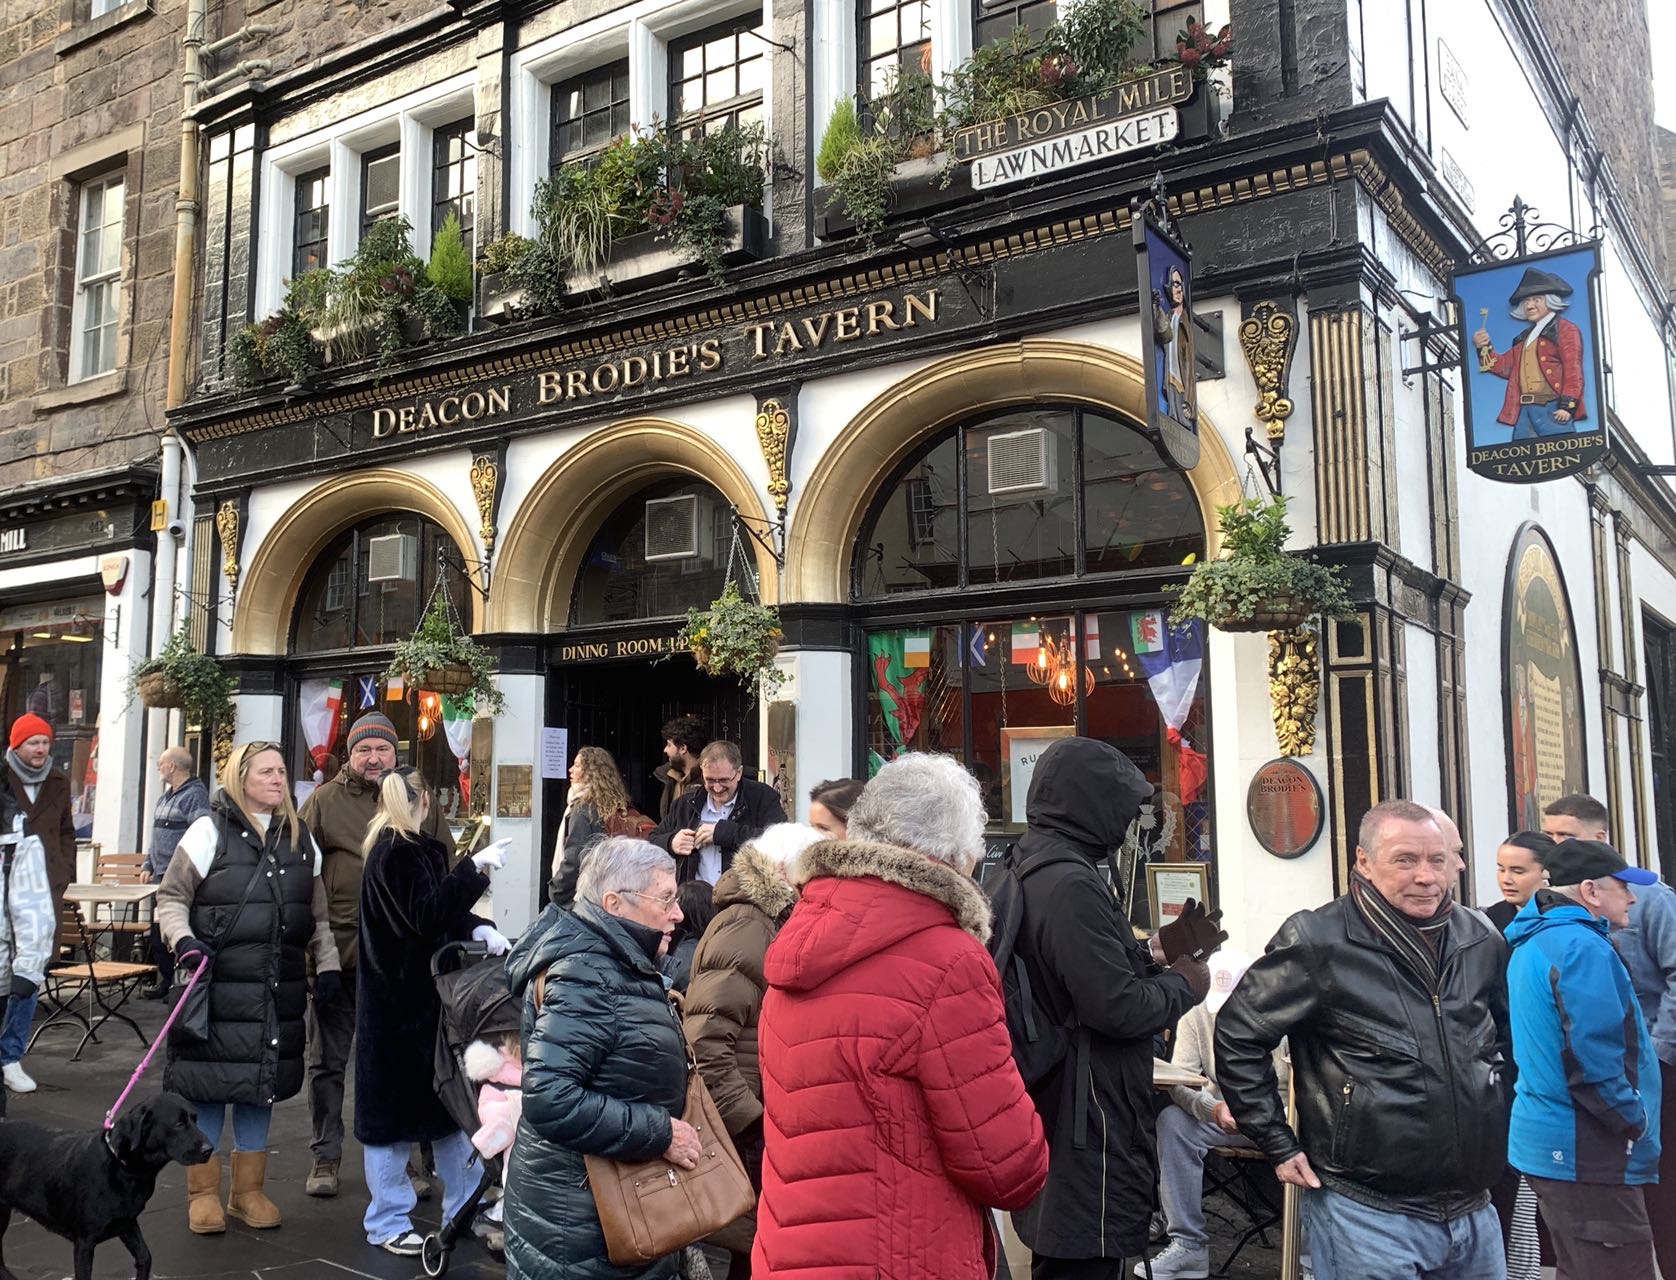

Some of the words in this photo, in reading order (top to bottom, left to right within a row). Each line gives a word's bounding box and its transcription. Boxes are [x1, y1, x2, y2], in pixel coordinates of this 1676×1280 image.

[959, 119, 1008, 155] THE
[1016, 96, 1105, 142] ROYAL
[1117, 71, 1186, 114] MILE
[977, 112, 1170, 187] LAWNMARKET
[371, 385, 513, 440] DEACON
[536, 339, 722, 406] BRODIE'S
[743, 288, 941, 362] TAVERN
[1471, 445, 1531, 466] DEACON
[1536, 434, 1604, 455] BRODIE'S
[1492, 454, 1582, 477] TAVERN
[0, 528, 26, 552] MILL
[562, 643, 609, 660] DINING
[616, 637, 662, 656] ROOM
[1020, 753, 1037, 766] RU
[1262, 776, 1304, 785] DEACON
